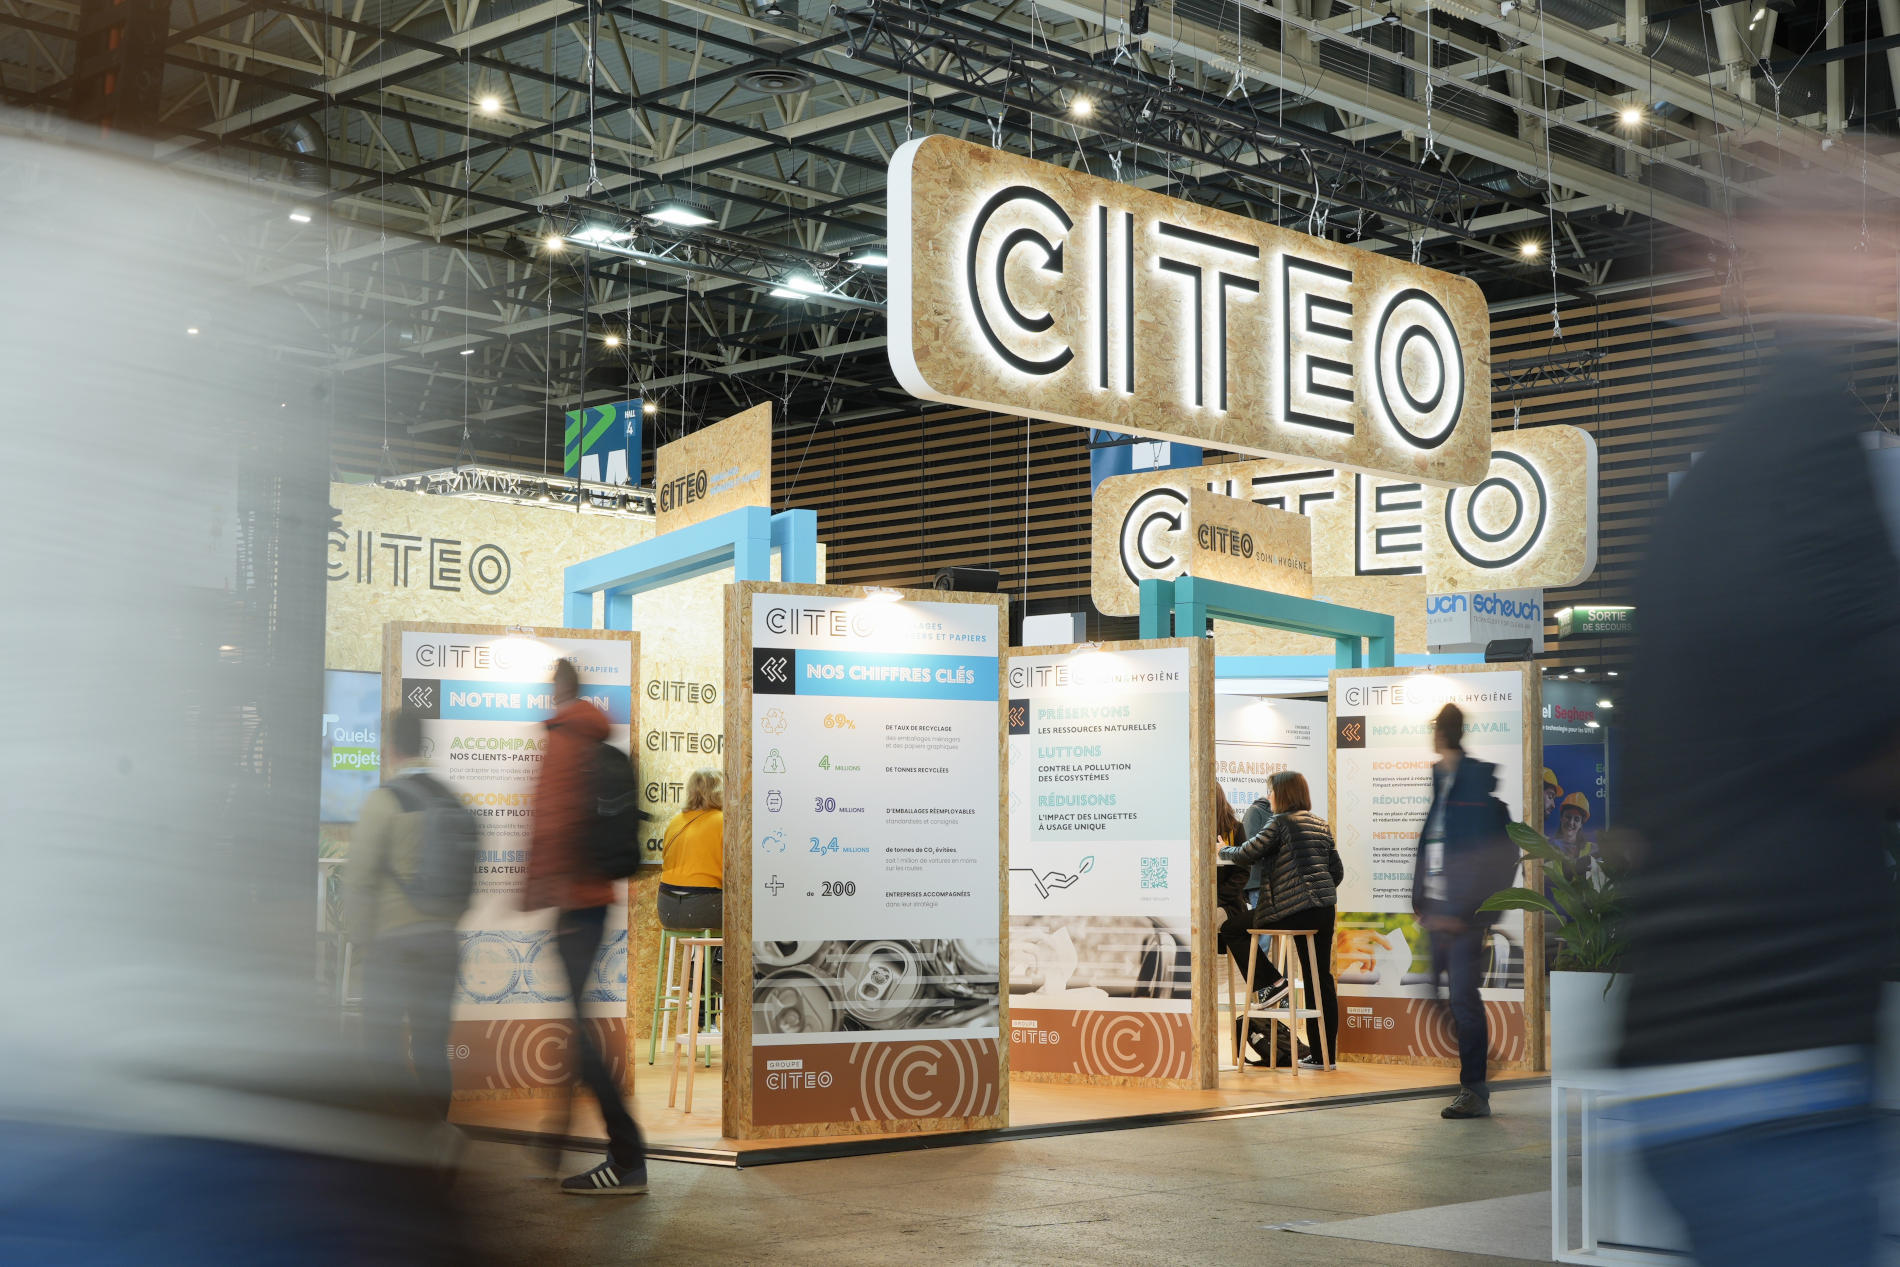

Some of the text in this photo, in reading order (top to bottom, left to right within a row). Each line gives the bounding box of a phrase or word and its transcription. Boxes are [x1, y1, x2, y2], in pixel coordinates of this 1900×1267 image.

[966, 185, 1465, 450] CITEO
[624, 409, 636, 419] HALL
[626, 421, 634, 435] 4
[660, 469, 708, 513] CITEO
[1197, 523, 1254, 559] CITEO
[1473, 592, 1541, 622] scheuch
[1582, 623, 1633, 632] DE SECOURS
[936, 633, 947, 642] ET
[949, 633, 988, 643] PAPIERS
[584, 665, 619, 673] PAPIERS
[806, 663, 975, 685] NOS CHIFFRES CLÉS
[1009, 664, 1077, 689] CITE
[647, 679, 717, 704] CITEO
[449, 692, 521, 709] NOTRE
[1037, 705, 1131, 721] PRÉSERVONS
[1554, 704, 1595, 723] Seghers
[823, 713, 856, 730] 69%
[1037, 723, 1157, 735] LES RESSOURCES NATURELLES
[333, 727, 377, 743] Quels
[1372, 725, 1397, 736] NOS
[450, 752, 469, 761] NOS
[1038, 745, 1102, 759] LUTTONS
[818, 755, 861, 772] 4 MILLIONS
[918, 765, 949, 774] RECYCLÉES
[1038, 763, 1132, 773] CONTRE LA POLLUTION
[1038, 772, 1110, 782] DES ÉCOSYSTÈMES
[814, 797, 836, 813] 30
[1038, 792, 1117, 807] RÉDUISONS
[495, 808, 504, 817] ET
[929, 807, 976, 815] RÉEMPLOYABLES
[1038, 812, 1137, 821] L'IMPACT DES LINGETTES
[1046, 823, 1072, 831] USAGE
[1074, 823, 1107, 832] UNIQUE
[809, 836, 840, 856] 2,4
[474, 865, 489, 874] LES
[821, 881, 856, 897] 200
[923, 889, 971, 897] ACCOMPAGNÉES
[1346, 1015, 1395, 1030] CITEO
[1011, 1029, 1061, 1046] CITEO
[769, 1060, 801, 1069] GROUPE
[766, 1071, 833, 1090] CITEO
